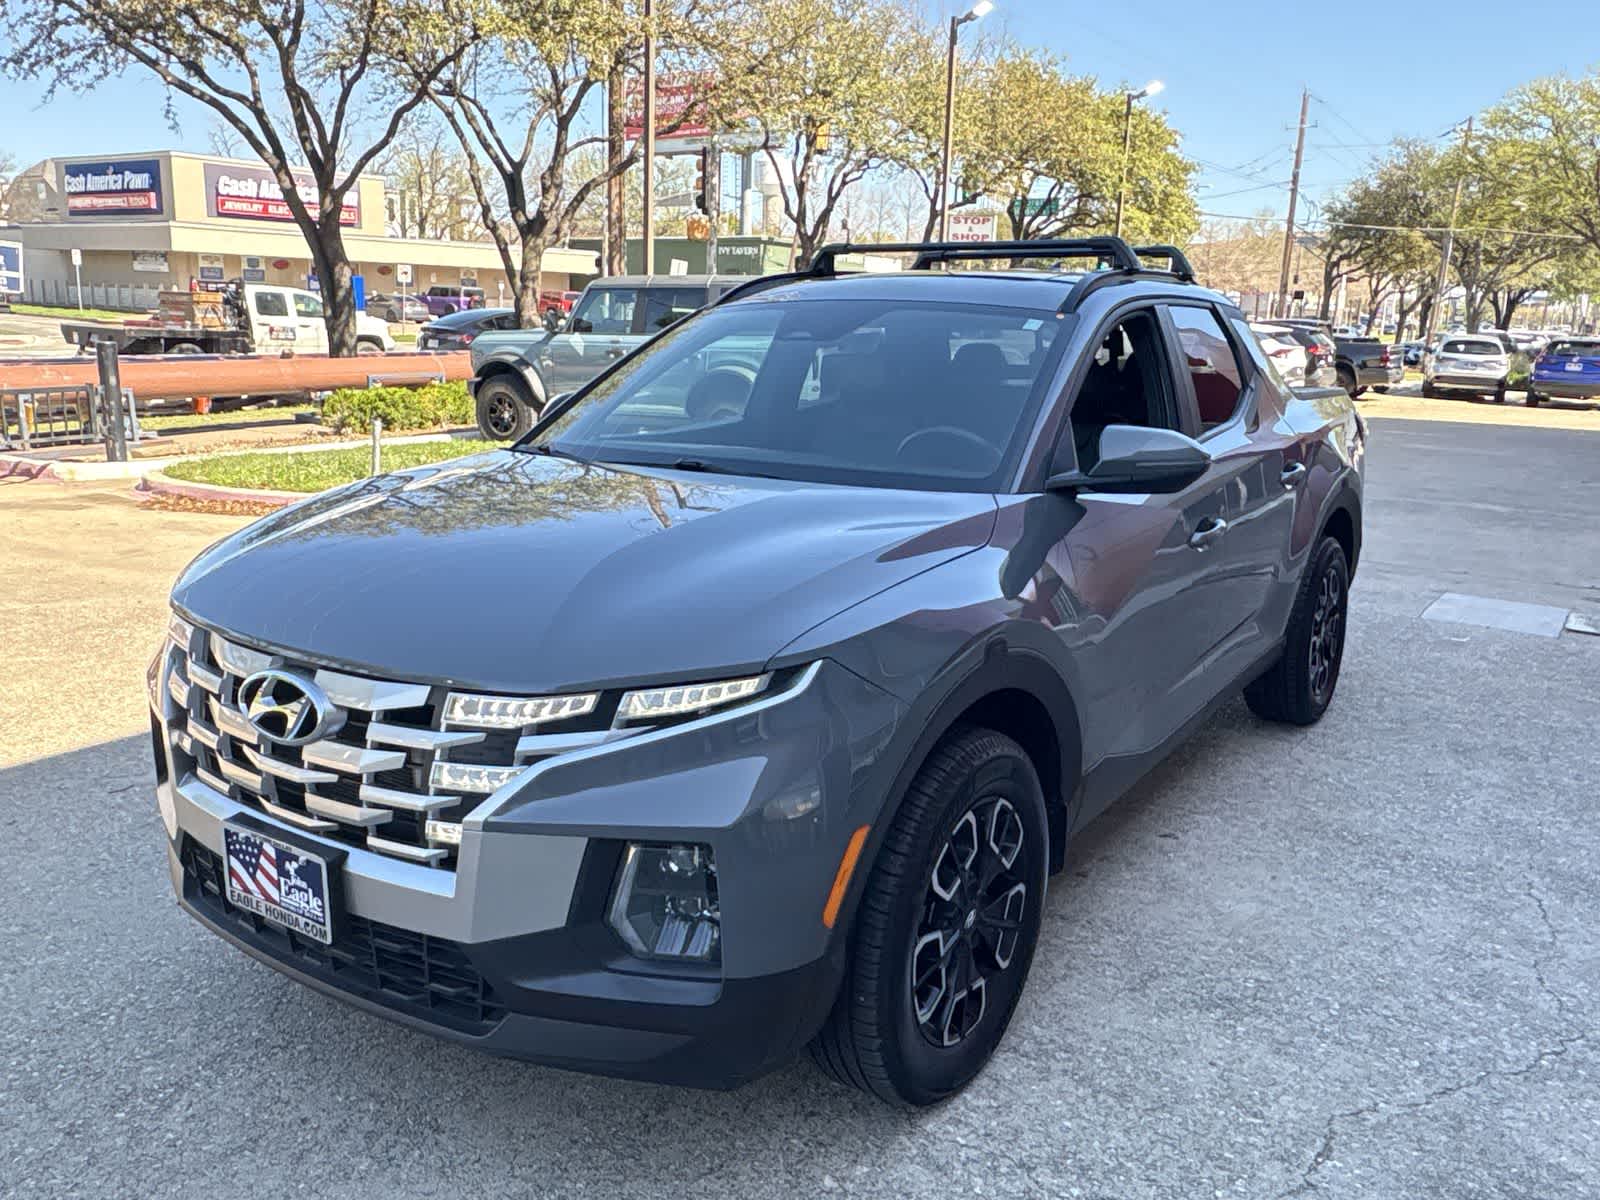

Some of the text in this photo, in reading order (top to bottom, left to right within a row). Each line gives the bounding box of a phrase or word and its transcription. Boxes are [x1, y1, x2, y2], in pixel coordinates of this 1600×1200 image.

[64, 170, 150, 192] Cash America Pawn
[218, 175, 257, 198] Cash
[223, 200, 264, 212] JEWELRY
[952, 216, 990, 226] STOP
[952, 233, 990, 242] SHOP
[718, 246, 759, 257] IVY TAVERN
[279, 876, 323, 912] Eagle
